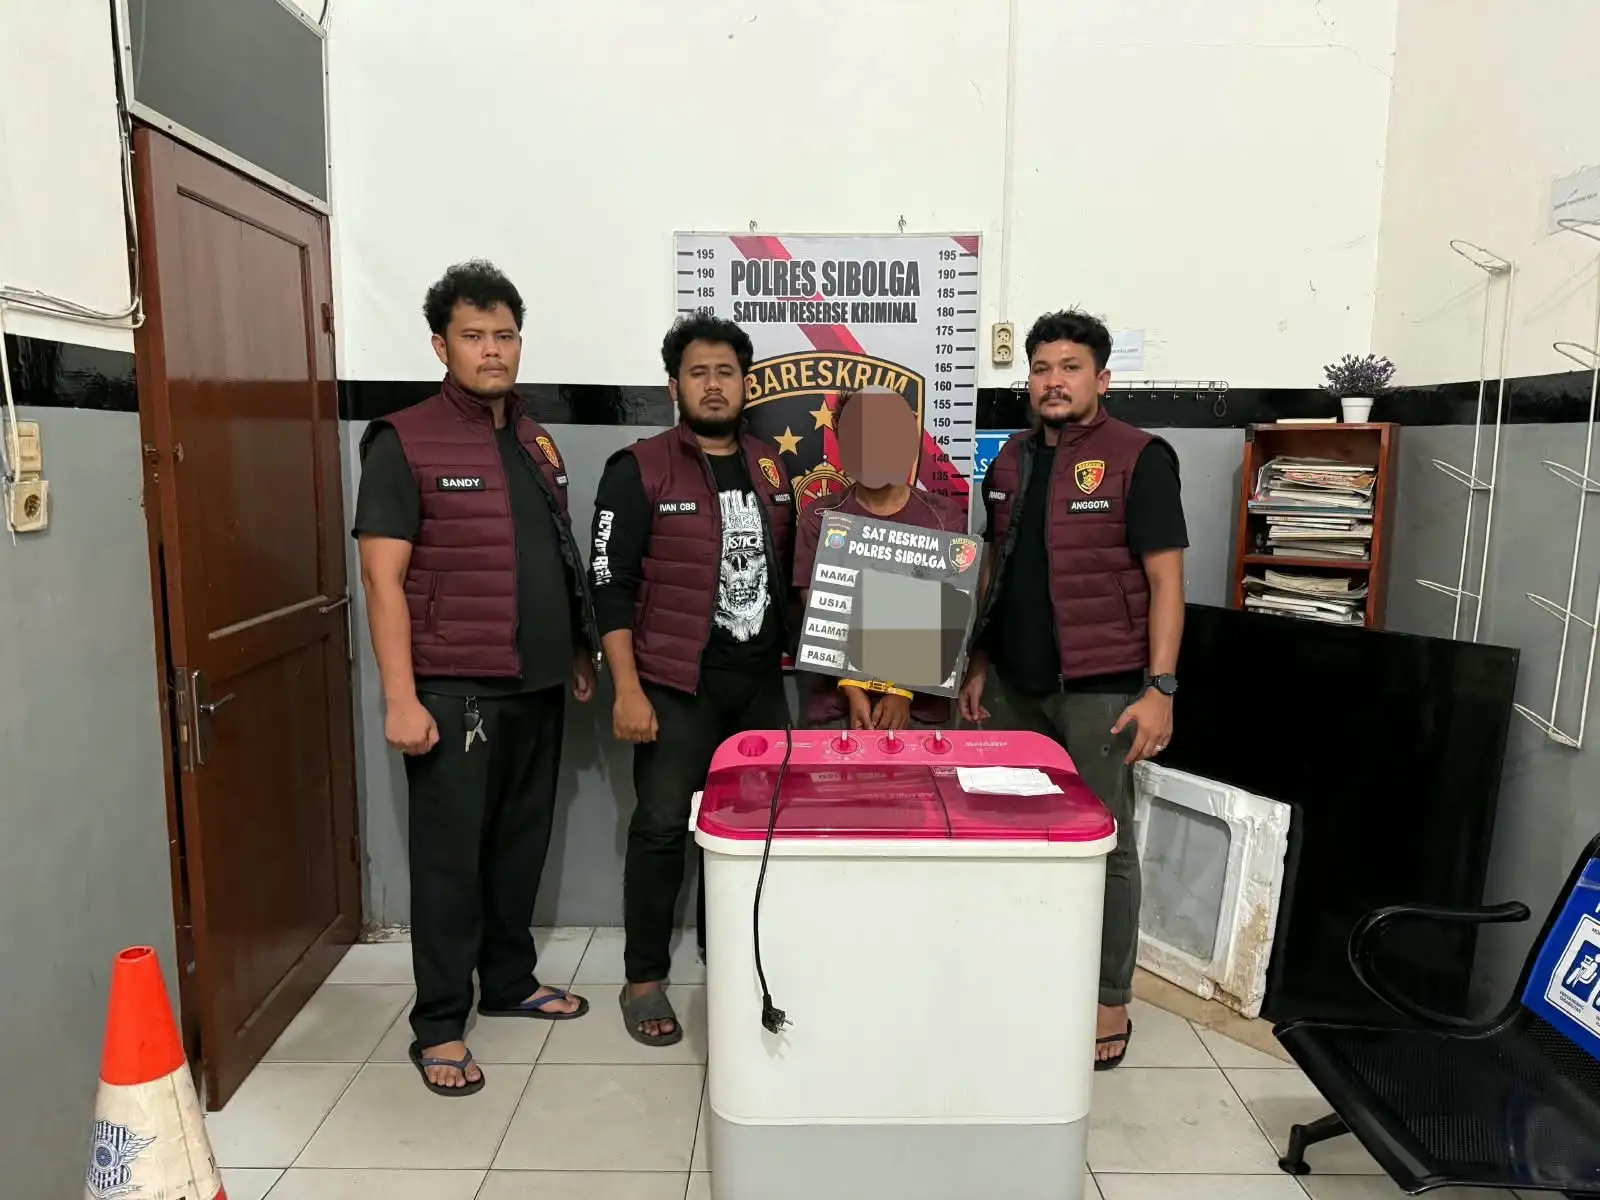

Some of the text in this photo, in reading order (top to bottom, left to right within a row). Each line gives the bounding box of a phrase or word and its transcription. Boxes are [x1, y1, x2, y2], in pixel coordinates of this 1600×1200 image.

[697, 249, 714, 259] 195
[938, 250, 956, 260] 195
[697, 268, 714, 278] 190
[938, 268, 956, 279] 190
[731, 260, 920, 297] POLRES SIBOLGA
[697, 287, 714, 297] 185
[937, 288, 955, 298] 185
[733, 301, 917, 324] SATUAN RESERSE KRIMINAL
[937, 306, 954, 317] 180
[935, 325, 954, 336] 175
[935, 344, 953, 355] 170
[935, 363, 952, 373] 165
[744, 360, 908, 400] BARESKRIM
[934, 381, 952, 391] 160
[933, 400, 951, 410] 155
[933, 417, 951, 427] 150
[932, 435, 950, 445] 145
[932, 454, 949, 463] 140
[442, 478, 480, 487] SANDY
[680, 502, 696, 511] CBS
[1071, 500, 1109, 510] ANGGOTA
[861, 525, 887, 542] SAT
[887, 529, 939, 552] RESKRIM
[848, 540, 947, 570] POLRES SIBOLGA
[819, 569, 855, 584] NAMA
[819, 596, 847, 610] USIA
[808, 623, 848, 638] ALAMAT
[807, 650, 838, 664] PASAL
